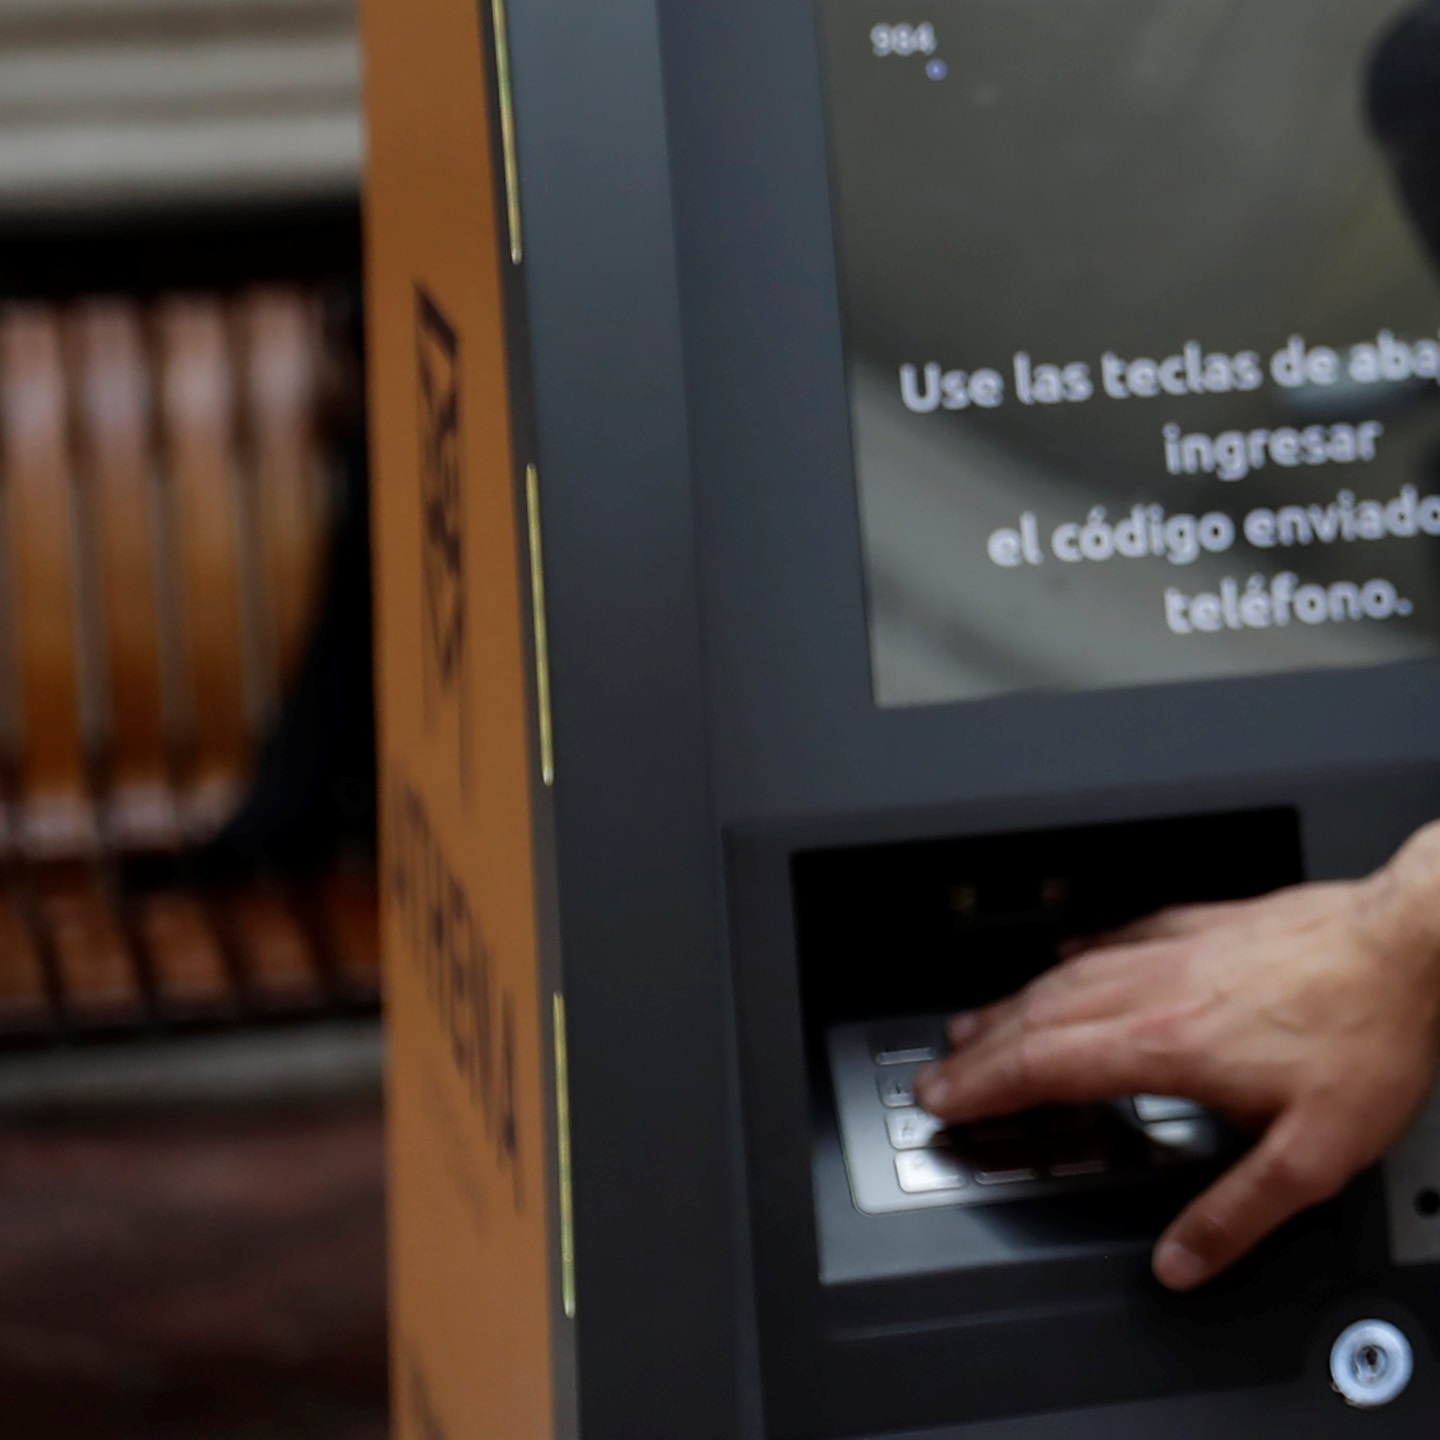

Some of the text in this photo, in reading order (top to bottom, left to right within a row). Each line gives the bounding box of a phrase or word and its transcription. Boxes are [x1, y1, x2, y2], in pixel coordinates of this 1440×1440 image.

[899, 362, 1003, 412] Use
[1014, 351, 1093, 406] las
[1102, 341, 1262, 397] teclas
[1270, 334, 1332, 389] de
[1163, 421, 1382, 481] ingresar
[986, 512, 1042, 567] el
[1052, 505, 1235, 565] código
[1164, 572, 1413, 635] teléfono.
